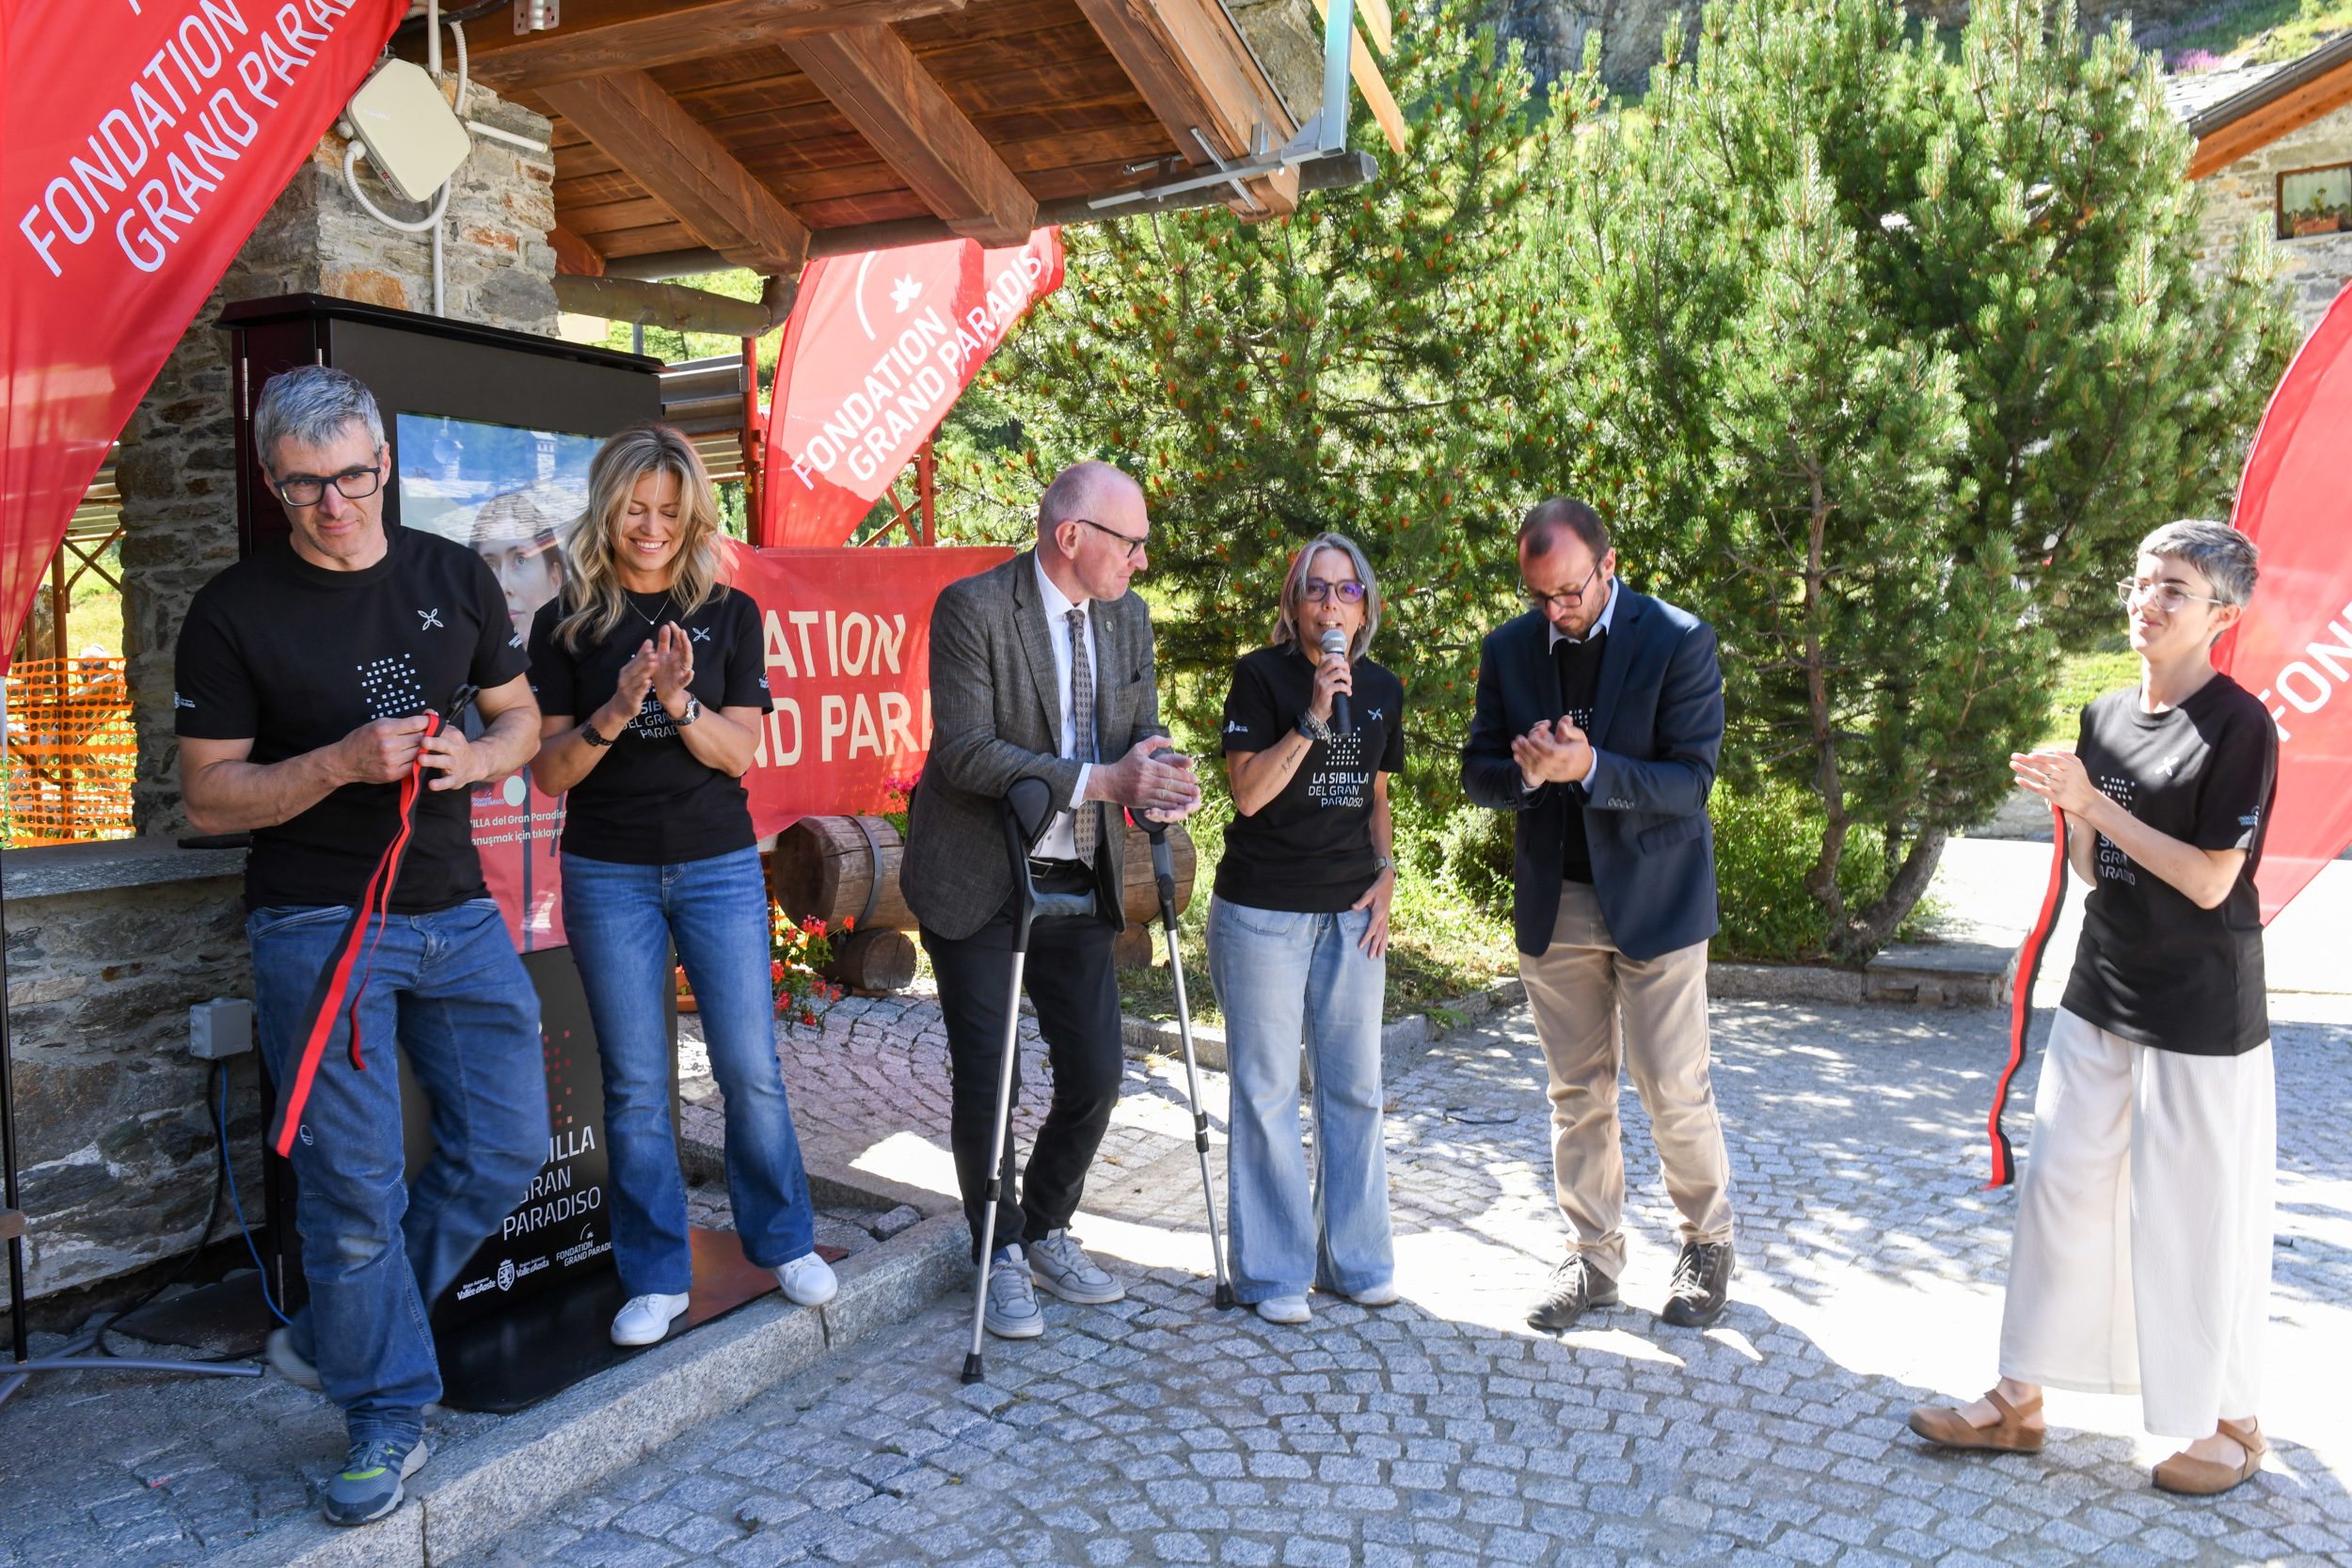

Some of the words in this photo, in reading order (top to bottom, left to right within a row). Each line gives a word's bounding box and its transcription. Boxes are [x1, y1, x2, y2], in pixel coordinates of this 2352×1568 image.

[19, 0, 248, 277] FONDATION
[116, 87, 259, 273] GRAND
[237, 0, 358, 109] PARA
[848, 365, 946, 481] GRAND
[937, 244, 1041, 376] PARADIS
[791, 306, 947, 490] FONDATION
[2258, 601, 2352, 743] FON
[1309, 785, 1327, 797] DEL
[1329, 784, 1359, 797] GRAN
[1312, 772, 1327, 784] LA
[1328, 772, 1369, 785] SIBILLA
[1321, 796, 1364, 808] PARADISO
[492, 816, 506, 826] del
[508, 814, 530, 825] Gran
[515, 830, 531, 844] için
[542, 1125, 596, 1164] ILLA
[503, 1186, 601, 1242] PARADISO
[556, 1240, 594, 1261] FONDATION
[564, 1251, 587, 1267] GRAND
[588, 1241, 612, 1258] PARADI
